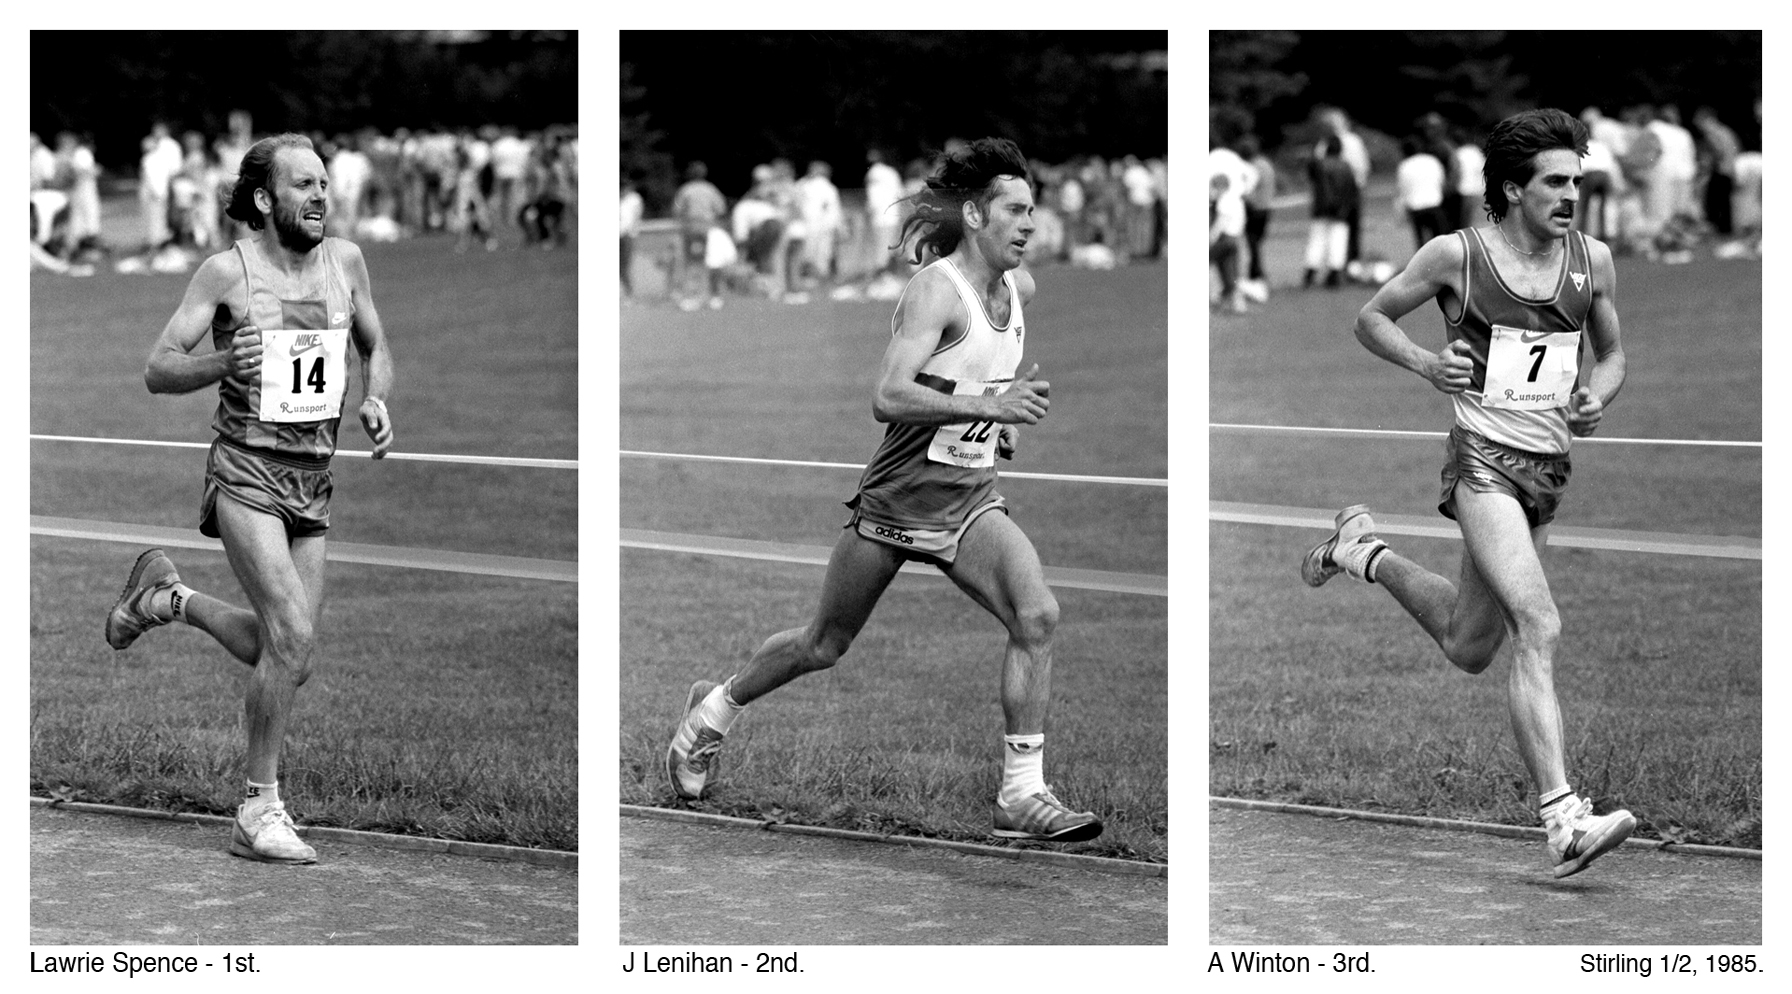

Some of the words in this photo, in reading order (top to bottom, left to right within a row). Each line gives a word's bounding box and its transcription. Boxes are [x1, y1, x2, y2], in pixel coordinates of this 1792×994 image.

[295, 334, 320, 346] NIKE
[1527, 345, 1547, 382] 7
[291, 356, 326, 394] 14
[1504, 389, 1555, 402] Runsport
[280, 402, 327, 414] Runsport
[960, 421, 995, 443] 22
[875, 526, 914, 545] adidas
